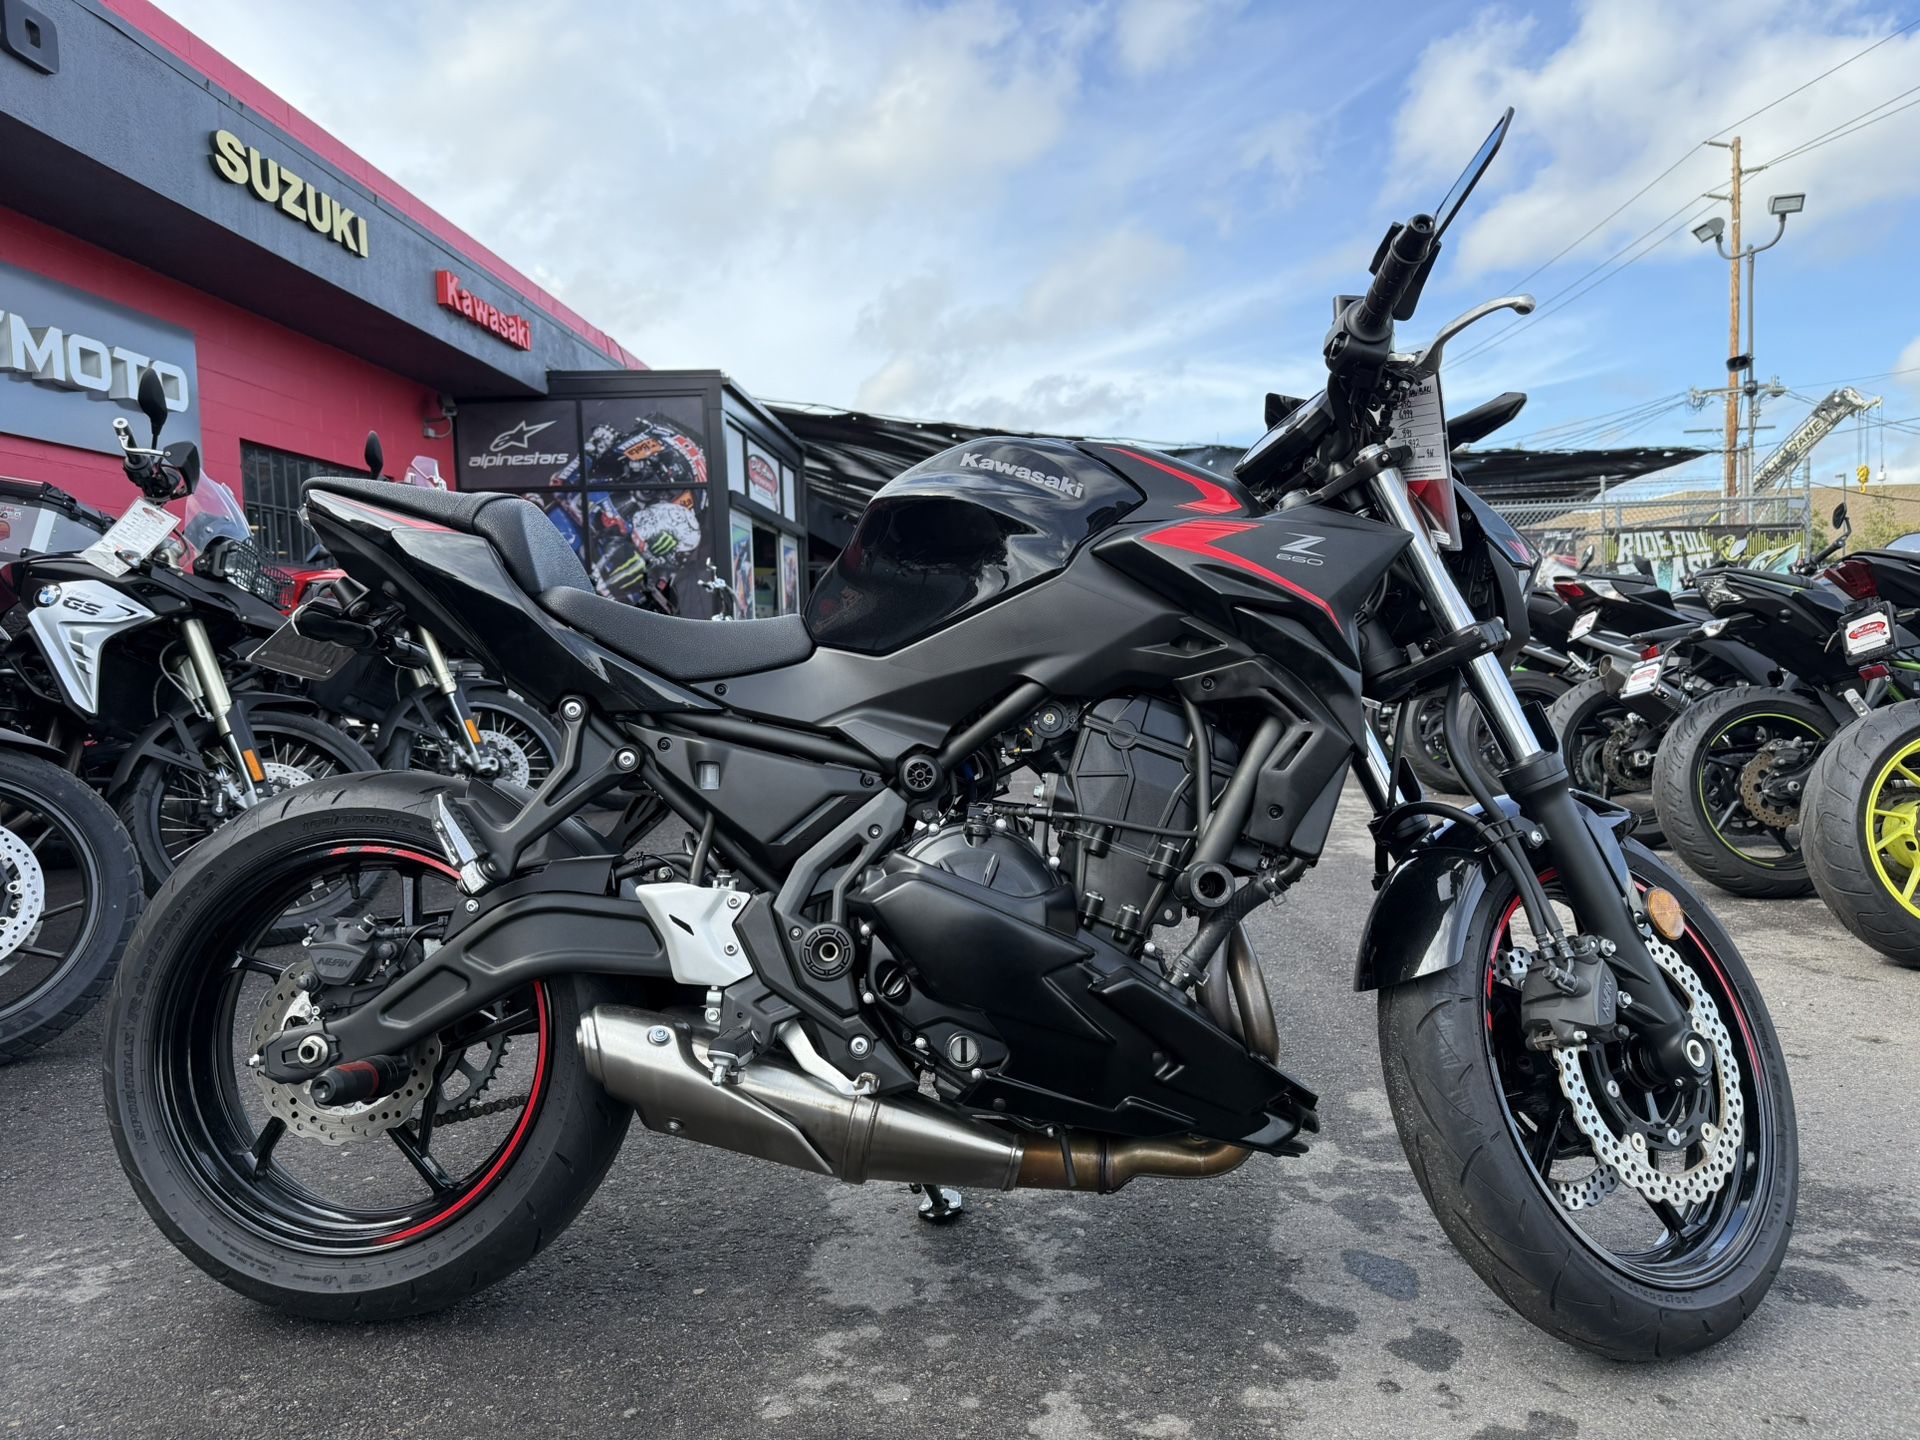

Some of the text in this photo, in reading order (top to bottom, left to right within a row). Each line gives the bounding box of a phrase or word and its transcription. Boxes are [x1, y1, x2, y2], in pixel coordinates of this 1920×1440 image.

[213, 129, 369, 258] SUZUKI
[443, 270, 532, 350] Kawasaki
[0, 310, 189, 413] MOTO
[469, 452, 569, 469] alpinestars
[960, 452, 1085, 499] Kawasaki
[1276, 553, 1324, 566] 650
[1279, 531, 1327, 558] Z
[1616, 530, 1712, 563] RIDE FULL
[62, 597, 104, 616] GS
[124, 1031, 147, 1141] SPORTMAX
